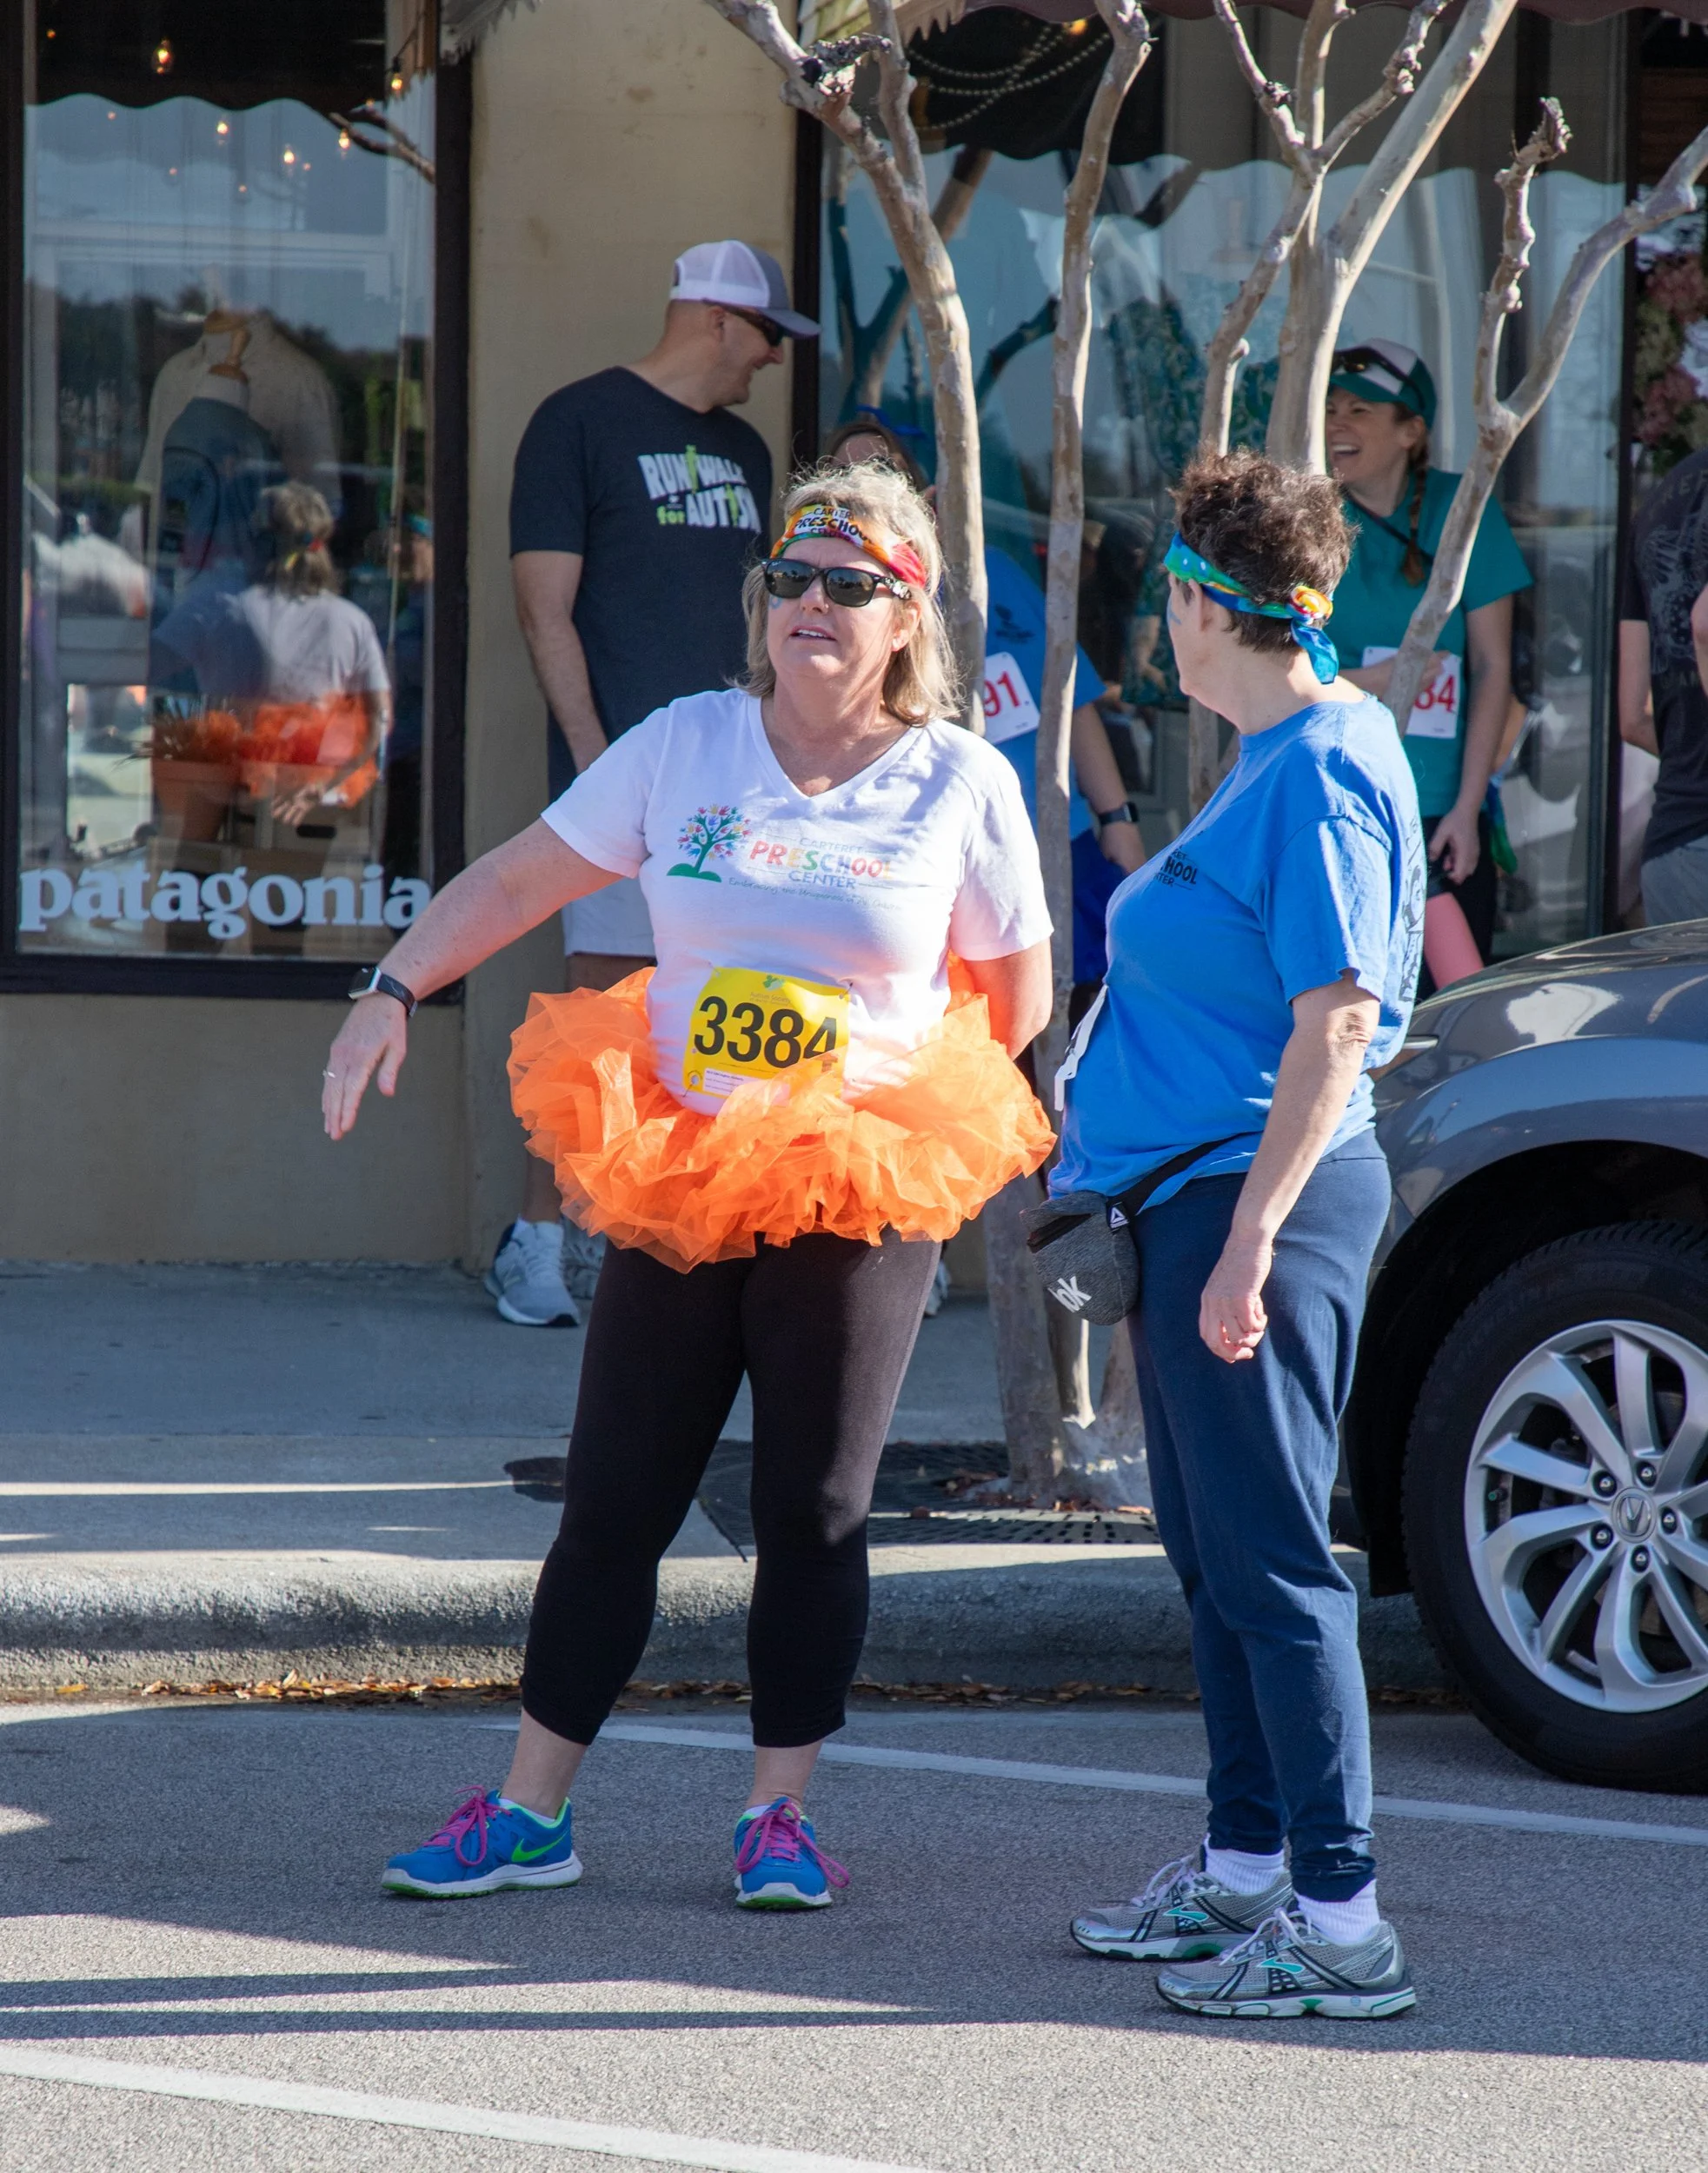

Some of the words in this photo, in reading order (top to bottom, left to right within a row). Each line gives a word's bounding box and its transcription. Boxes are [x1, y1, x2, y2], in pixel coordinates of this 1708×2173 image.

[748, 840, 894, 880] PRESCHOOL
[799, 837, 863, 854] CARTERET
[788, 870, 857, 889] CENTER
[18, 864, 432, 940] patagonia
[694, 995, 838, 1073] 3384
